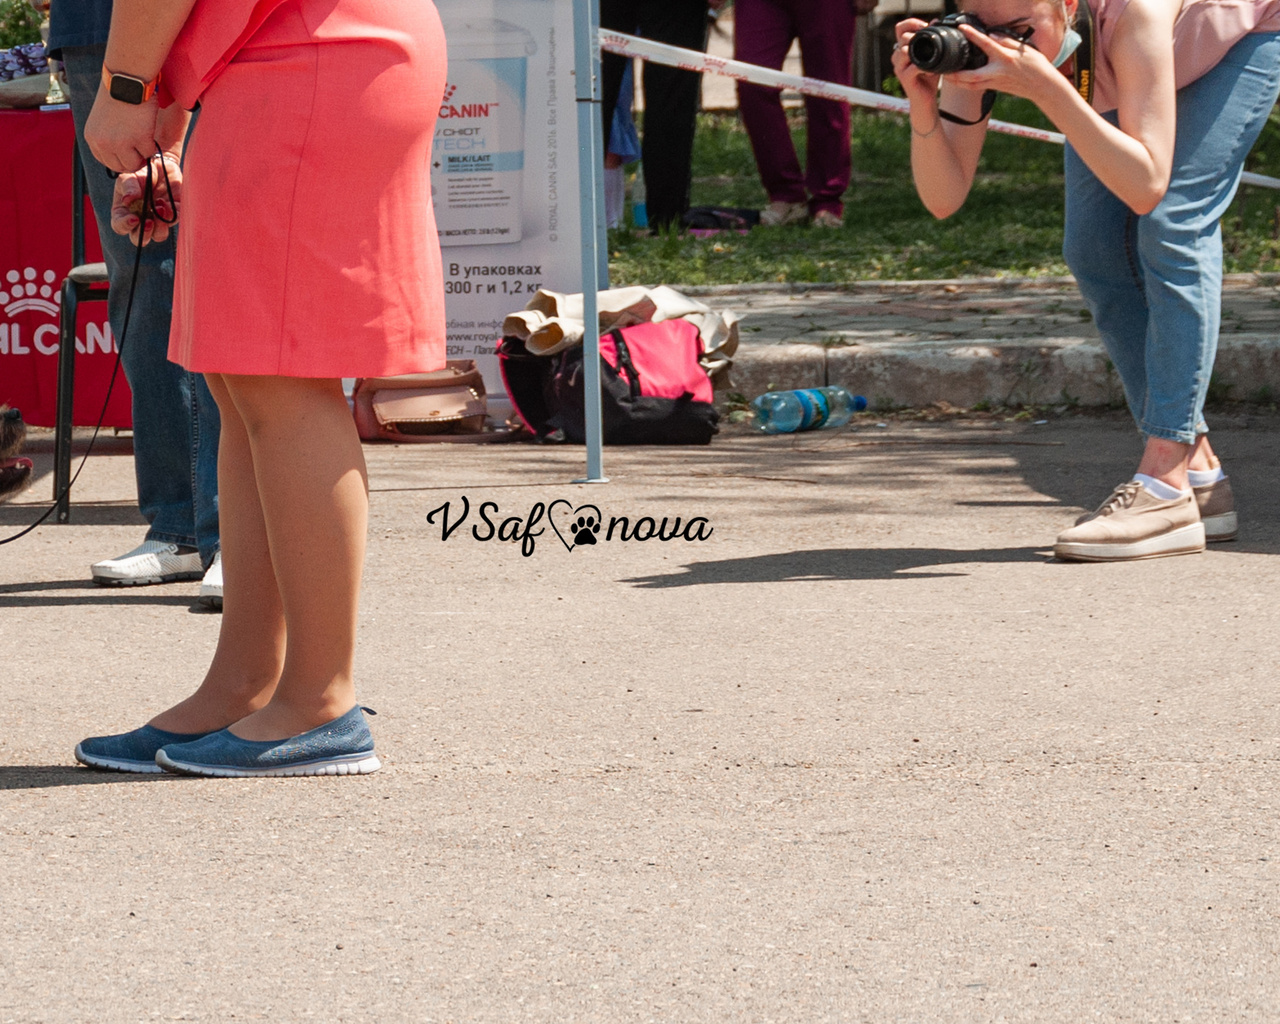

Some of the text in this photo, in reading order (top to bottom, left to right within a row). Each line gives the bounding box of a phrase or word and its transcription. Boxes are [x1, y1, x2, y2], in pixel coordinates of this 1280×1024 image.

[438, 103, 490, 118] CANIN
[547, 108, 557, 126] Все
[547, 151, 557, 169] SAS
[548, 171, 558, 201] CANIN
[548, 203, 558, 231] ROYAL
[449, 263, 542, 279] В упаковках
[445, 280, 472, 294] 300
[476, 283, 483, 293] г
[487, 283, 496, 293] и
[501, 280, 522, 295] 1,2
[446, 332, 503, 343] www.royal-
[446, 345, 464, 355] ECH
